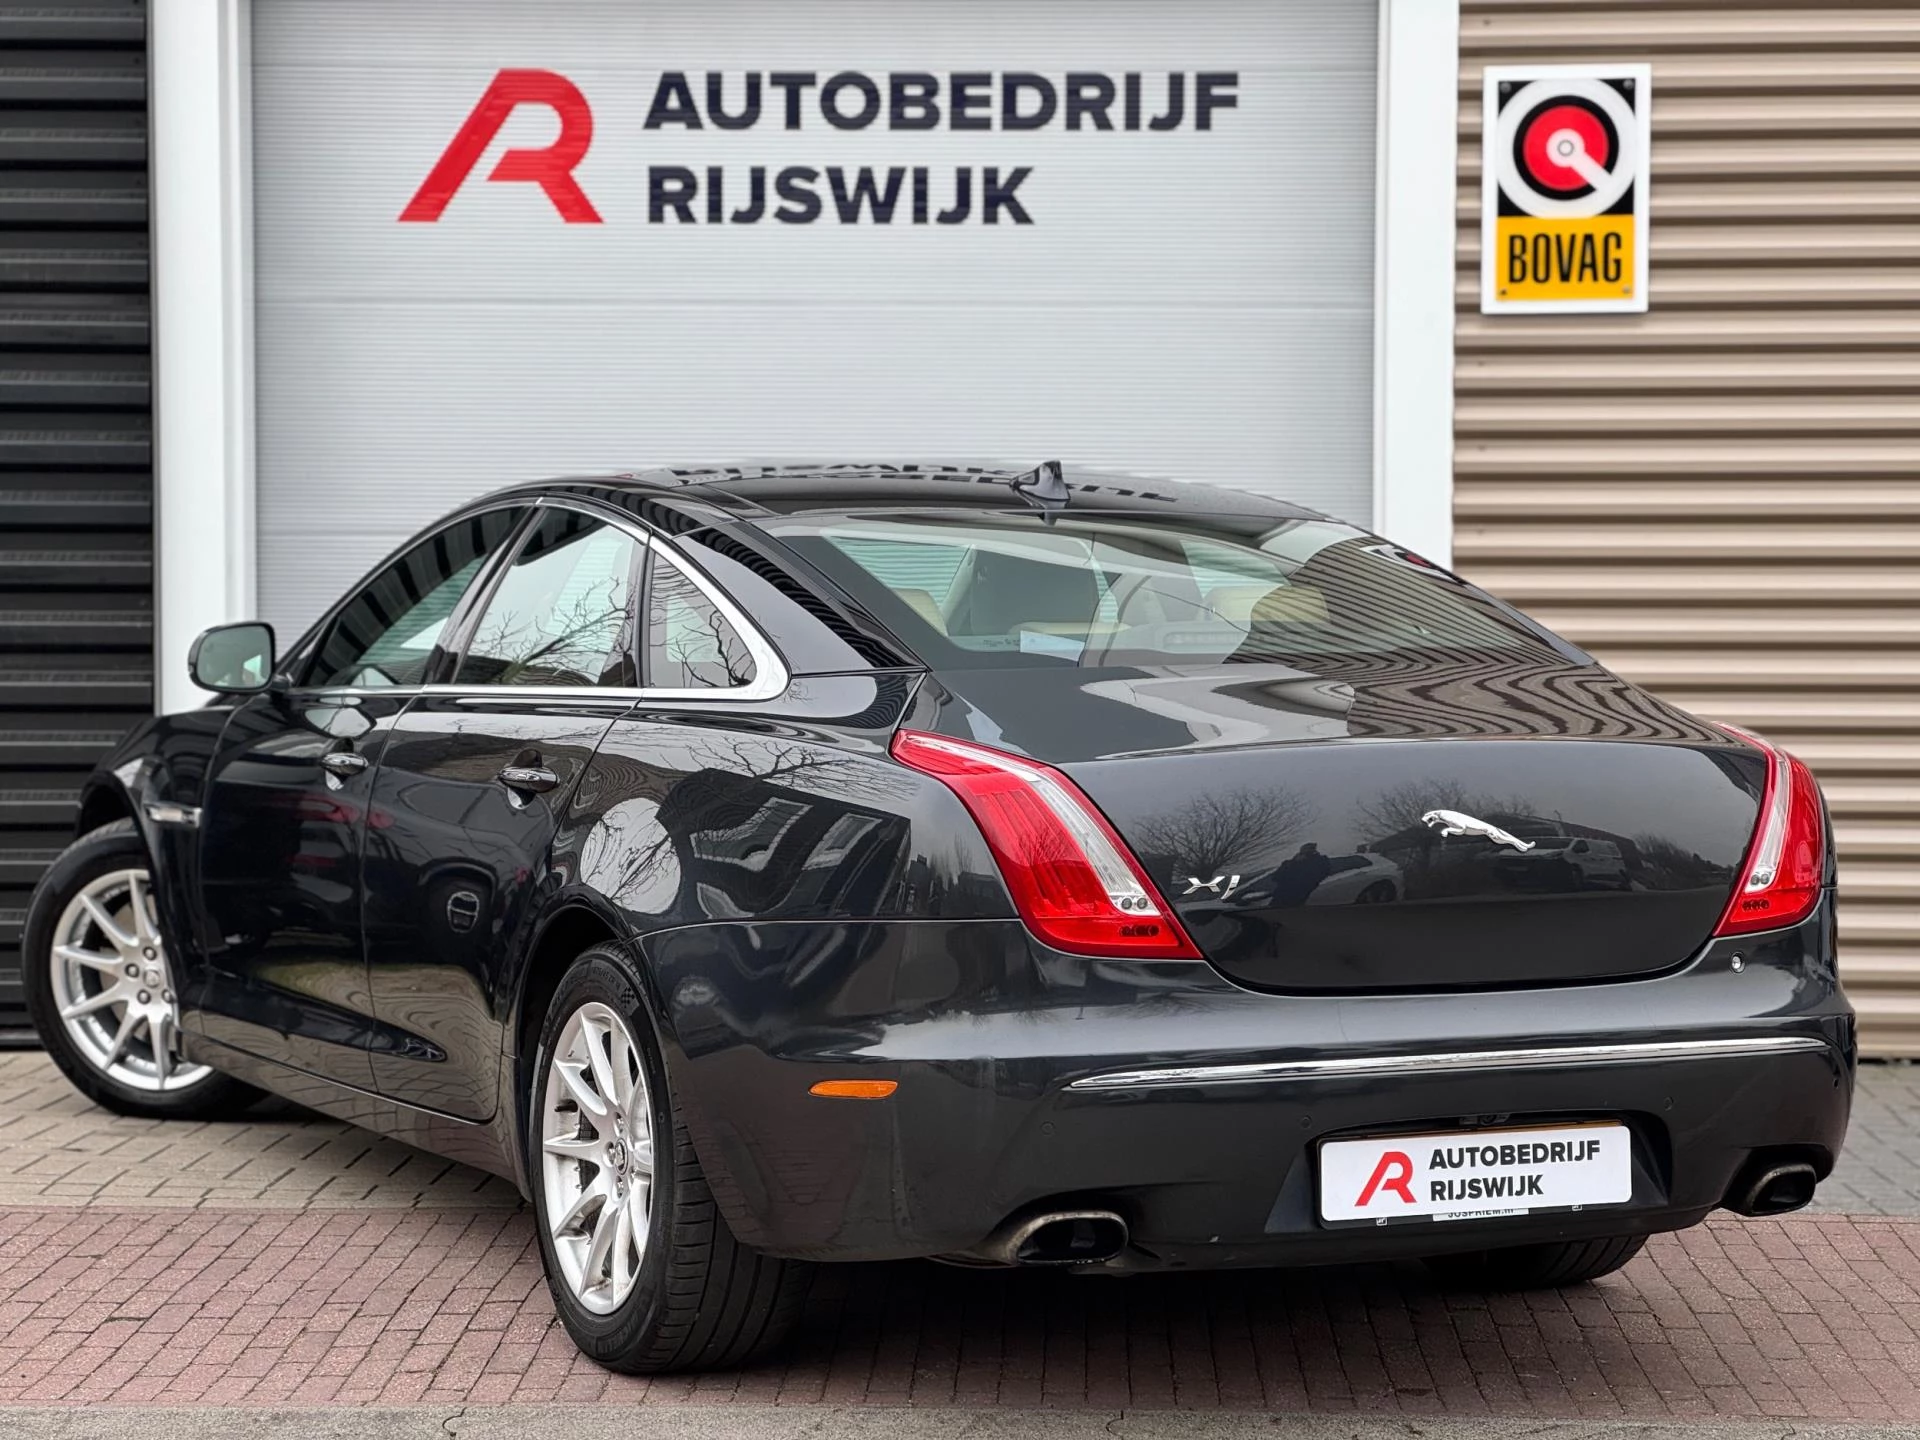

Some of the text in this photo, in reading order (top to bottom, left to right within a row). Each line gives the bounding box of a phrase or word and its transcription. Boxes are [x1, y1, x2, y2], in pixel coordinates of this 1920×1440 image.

[643, 71, 1240, 132] AUTOBEDRIJF
[648, 166, 1035, 226] RIJSWIJK
[1508, 232, 1623, 284] BOVAG
[1429, 1140, 1600, 1170] AUTOBEDRIJF
[1430, 1174, 1544, 1202] RIJSWIJK
